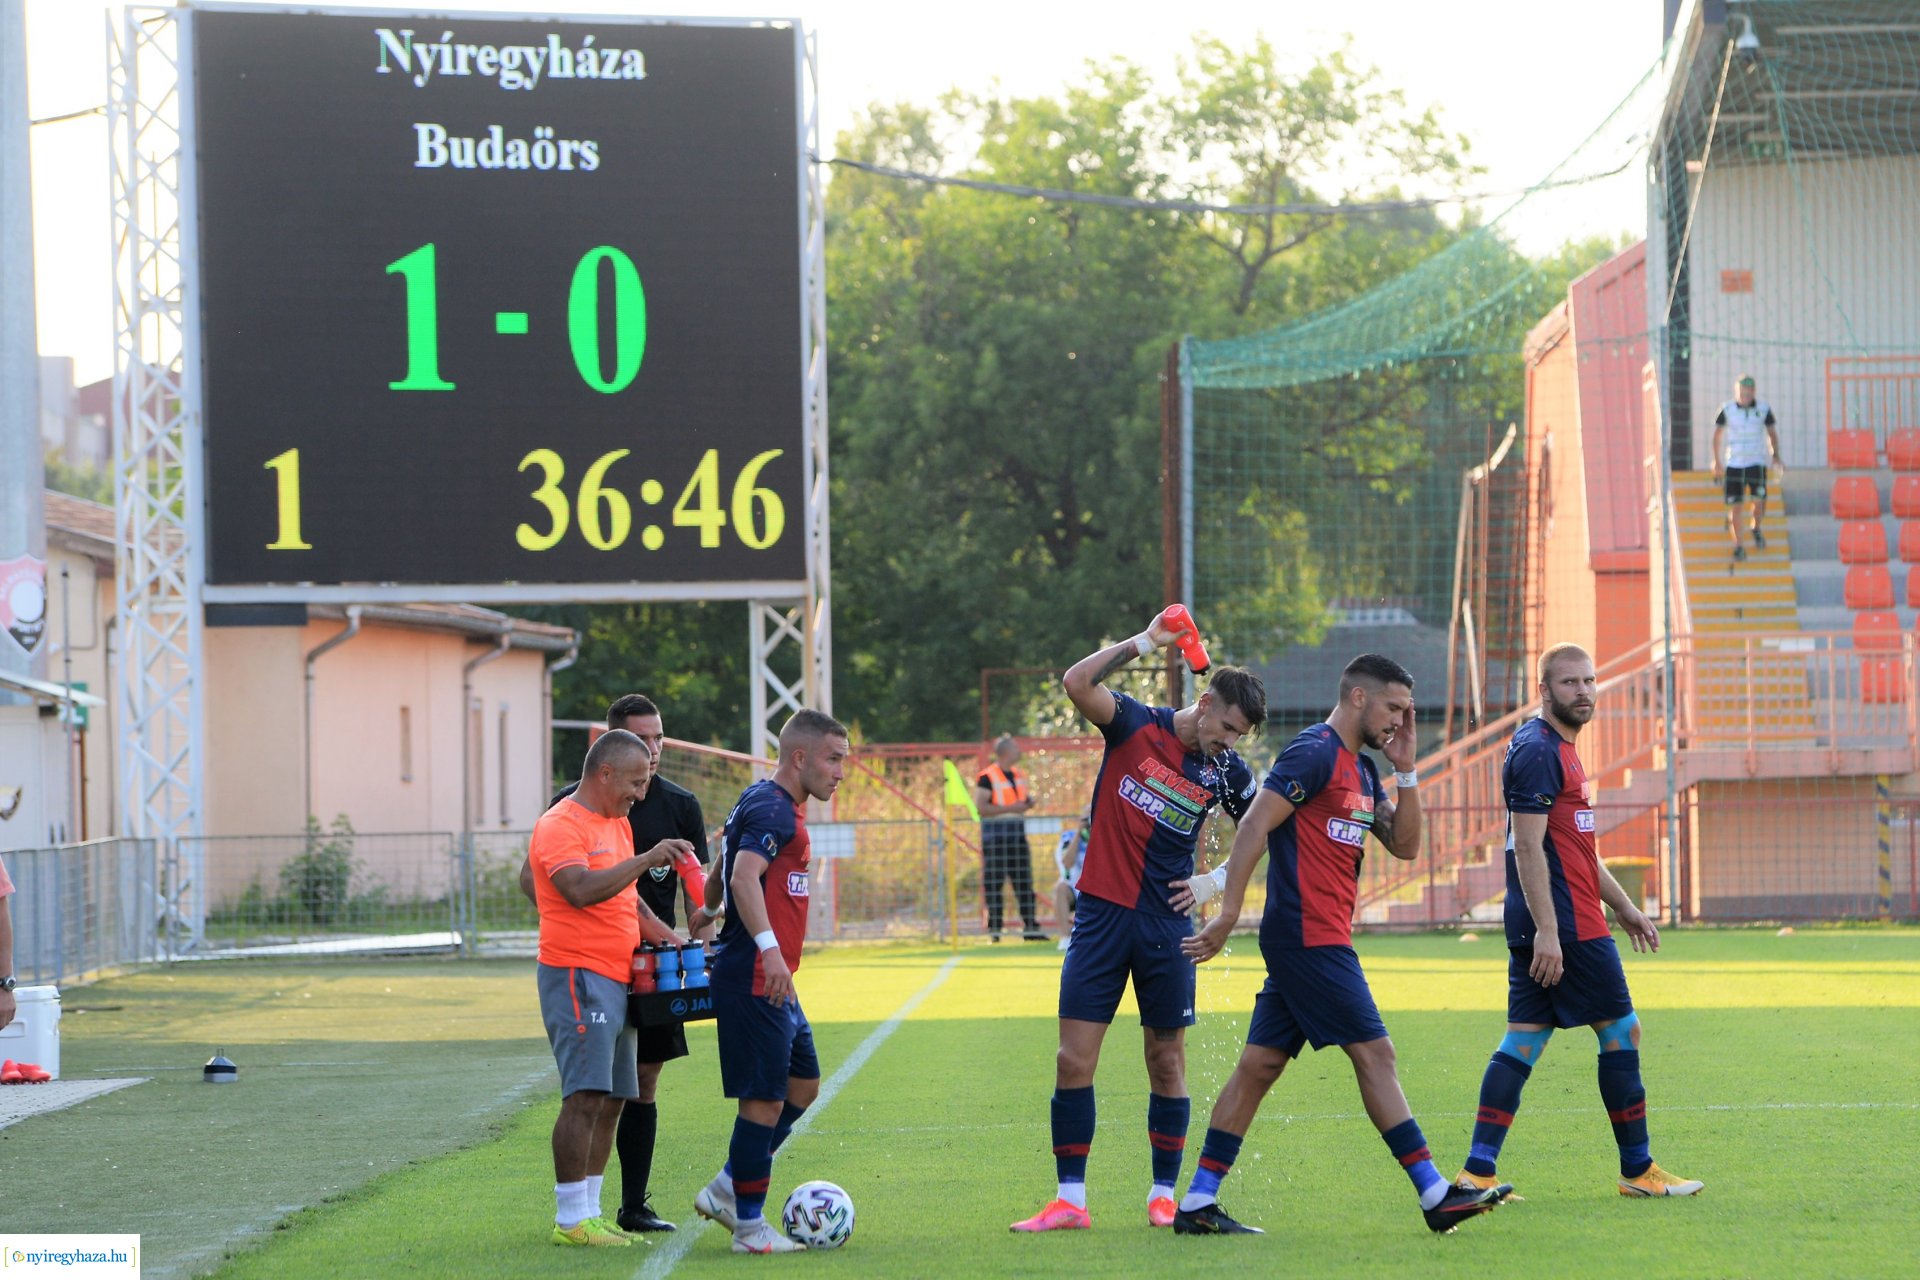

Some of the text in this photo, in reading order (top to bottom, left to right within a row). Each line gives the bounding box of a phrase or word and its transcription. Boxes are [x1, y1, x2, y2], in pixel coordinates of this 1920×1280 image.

[375, 28, 648, 90] Nyíregyháza
[412, 122, 601, 172] Budaörs
[385, 242, 647, 394] 1 - 0
[264, 447, 786, 552] 1 36:46
[591, 1012, 607, 1024] T.A.
